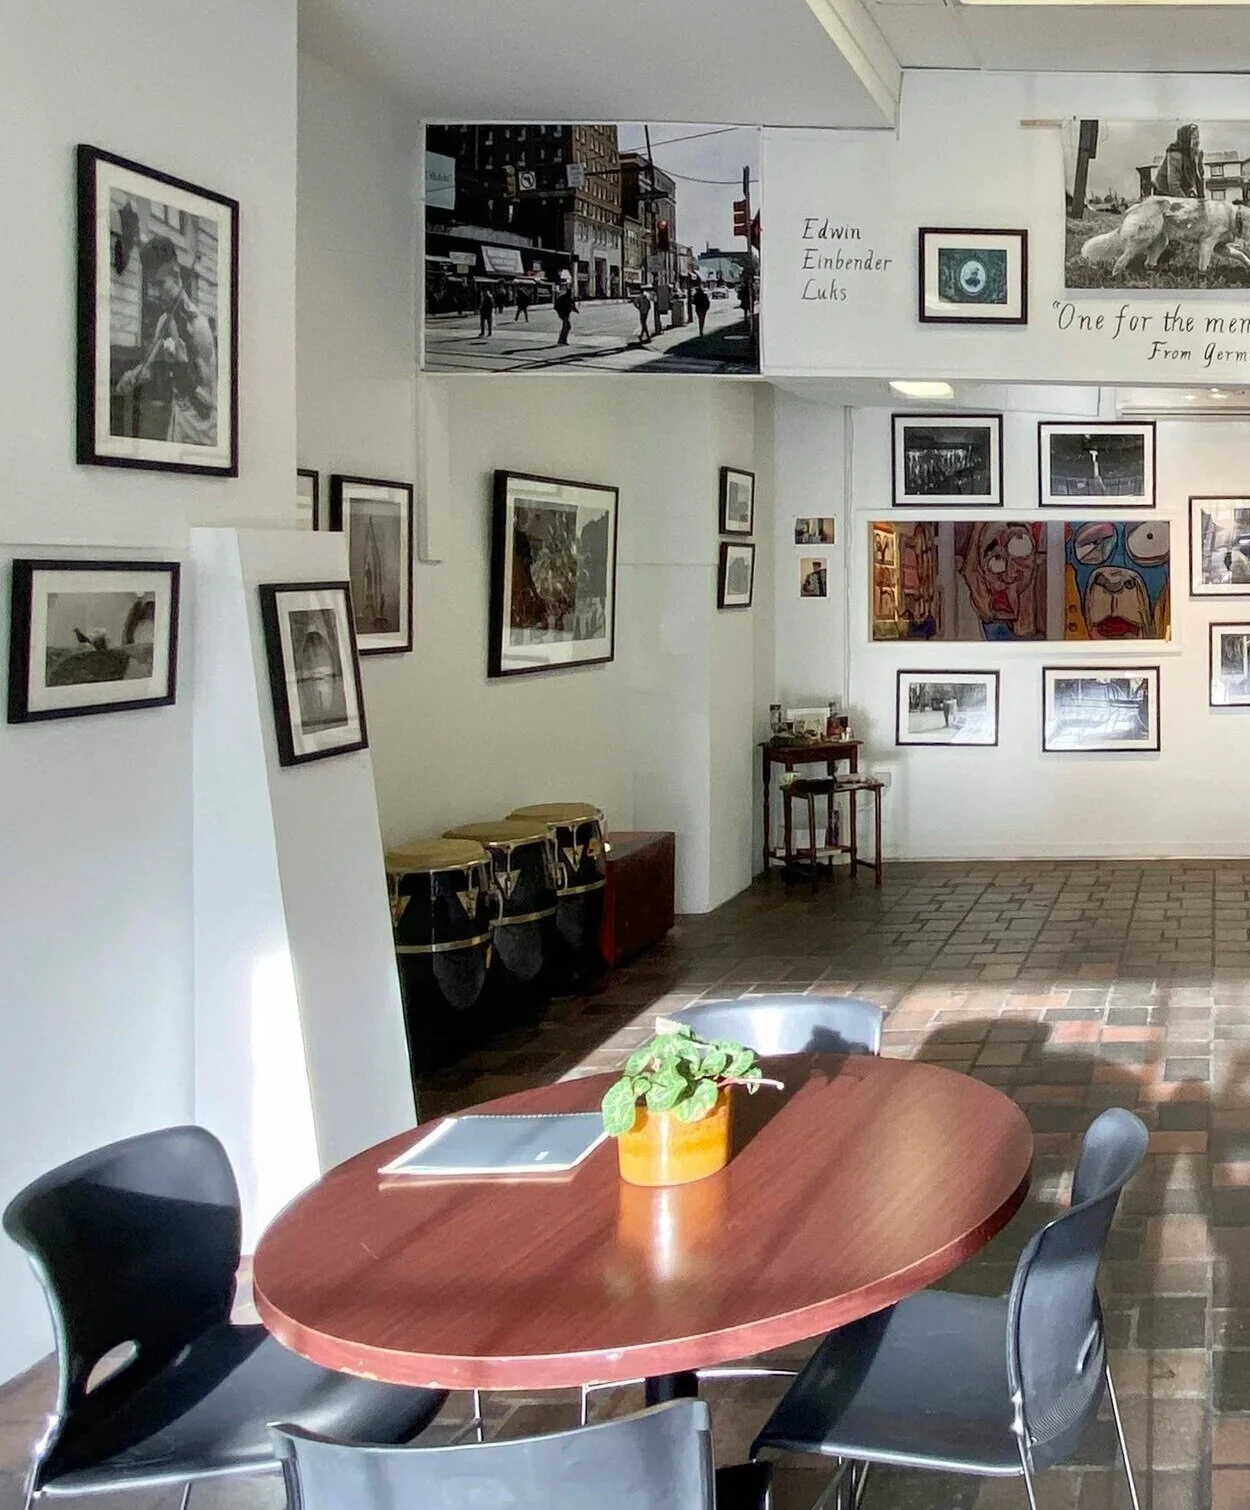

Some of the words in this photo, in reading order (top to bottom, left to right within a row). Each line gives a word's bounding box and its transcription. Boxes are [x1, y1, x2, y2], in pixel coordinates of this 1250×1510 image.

[802, 218, 862, 240] Edwin
[802, 248, 893, 271] Einbender
[801, 278, 847, 301] Luks
[1112, 304, 1152, 340] for
[1163, 303, 1195, 333] the
[1147, 341, 1192, 361] From
